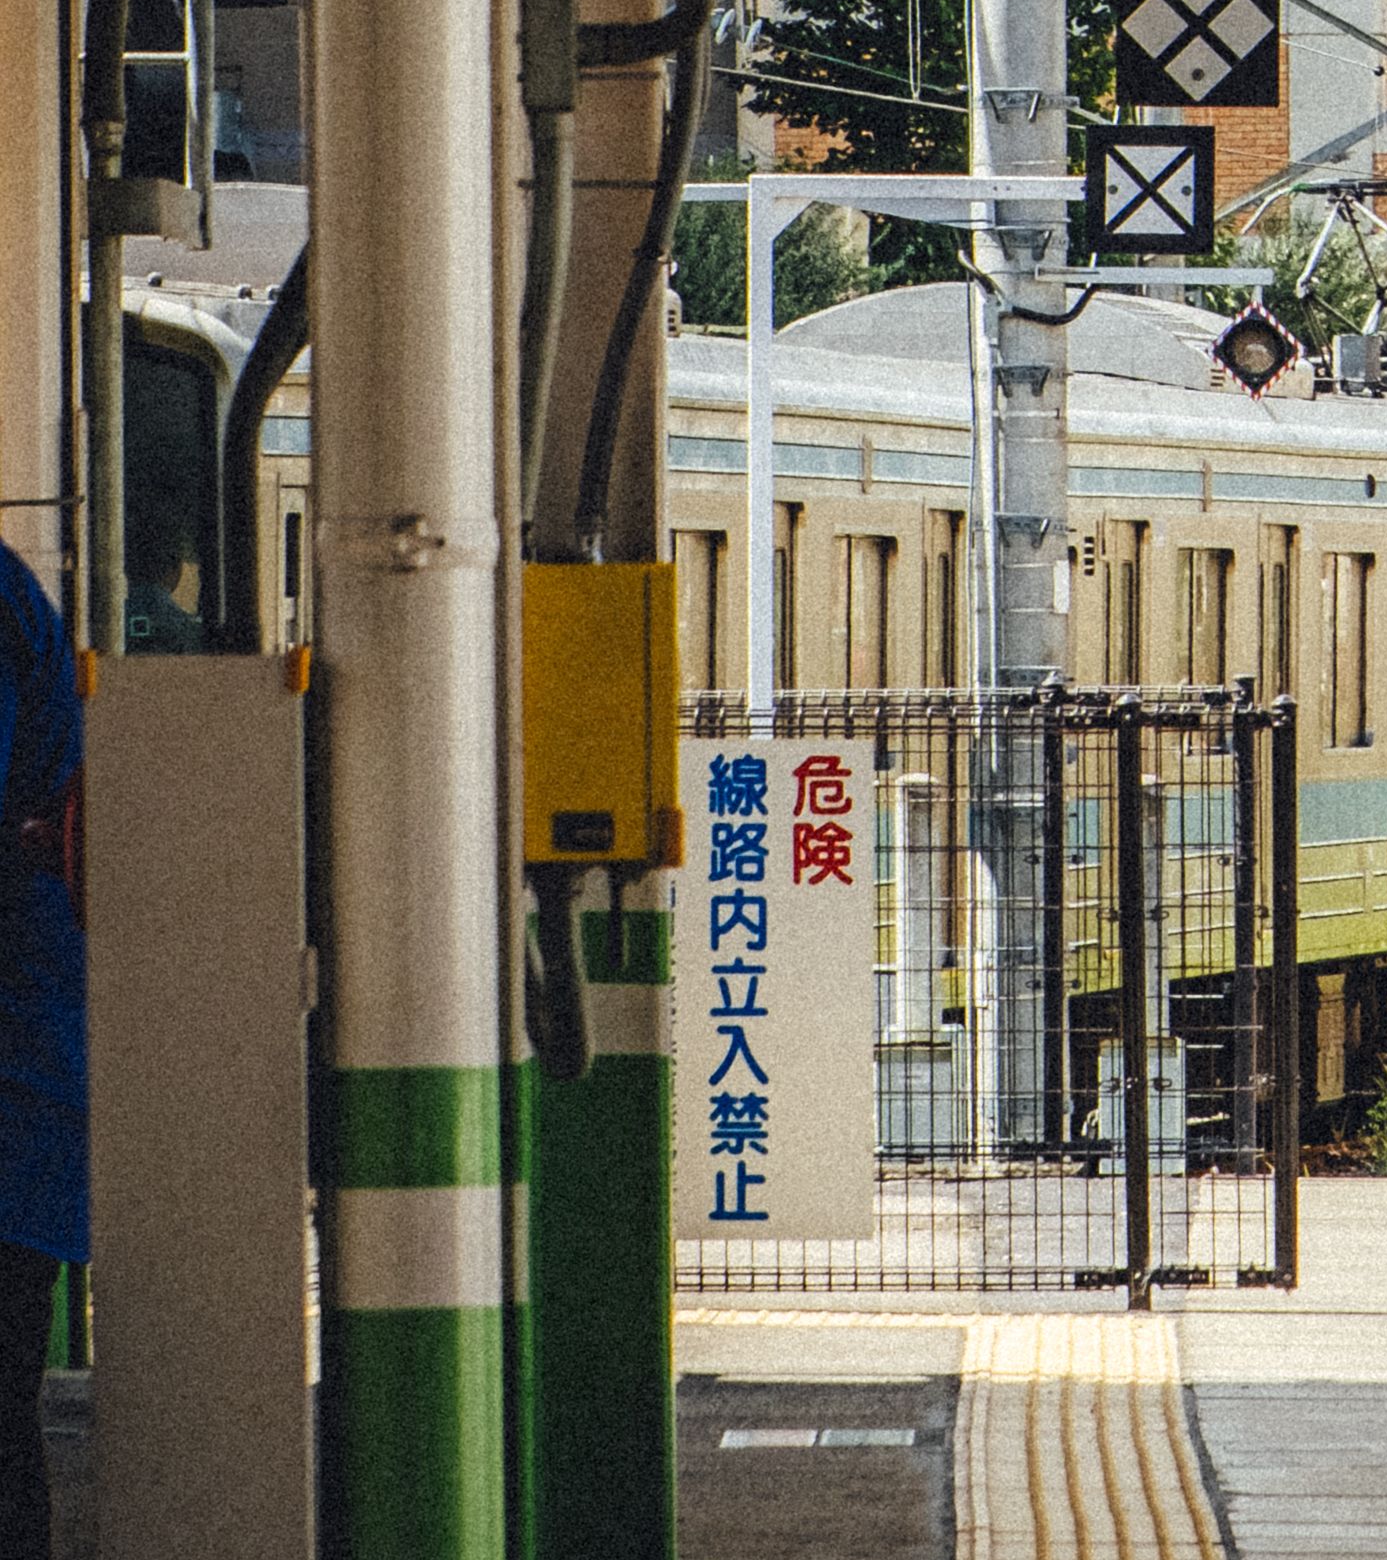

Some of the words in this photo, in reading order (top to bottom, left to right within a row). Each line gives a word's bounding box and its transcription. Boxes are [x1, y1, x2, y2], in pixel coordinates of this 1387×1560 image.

[791, 754, 854, 886] 危険
[707, 752, 770, 1222] 線路内立入禁止
